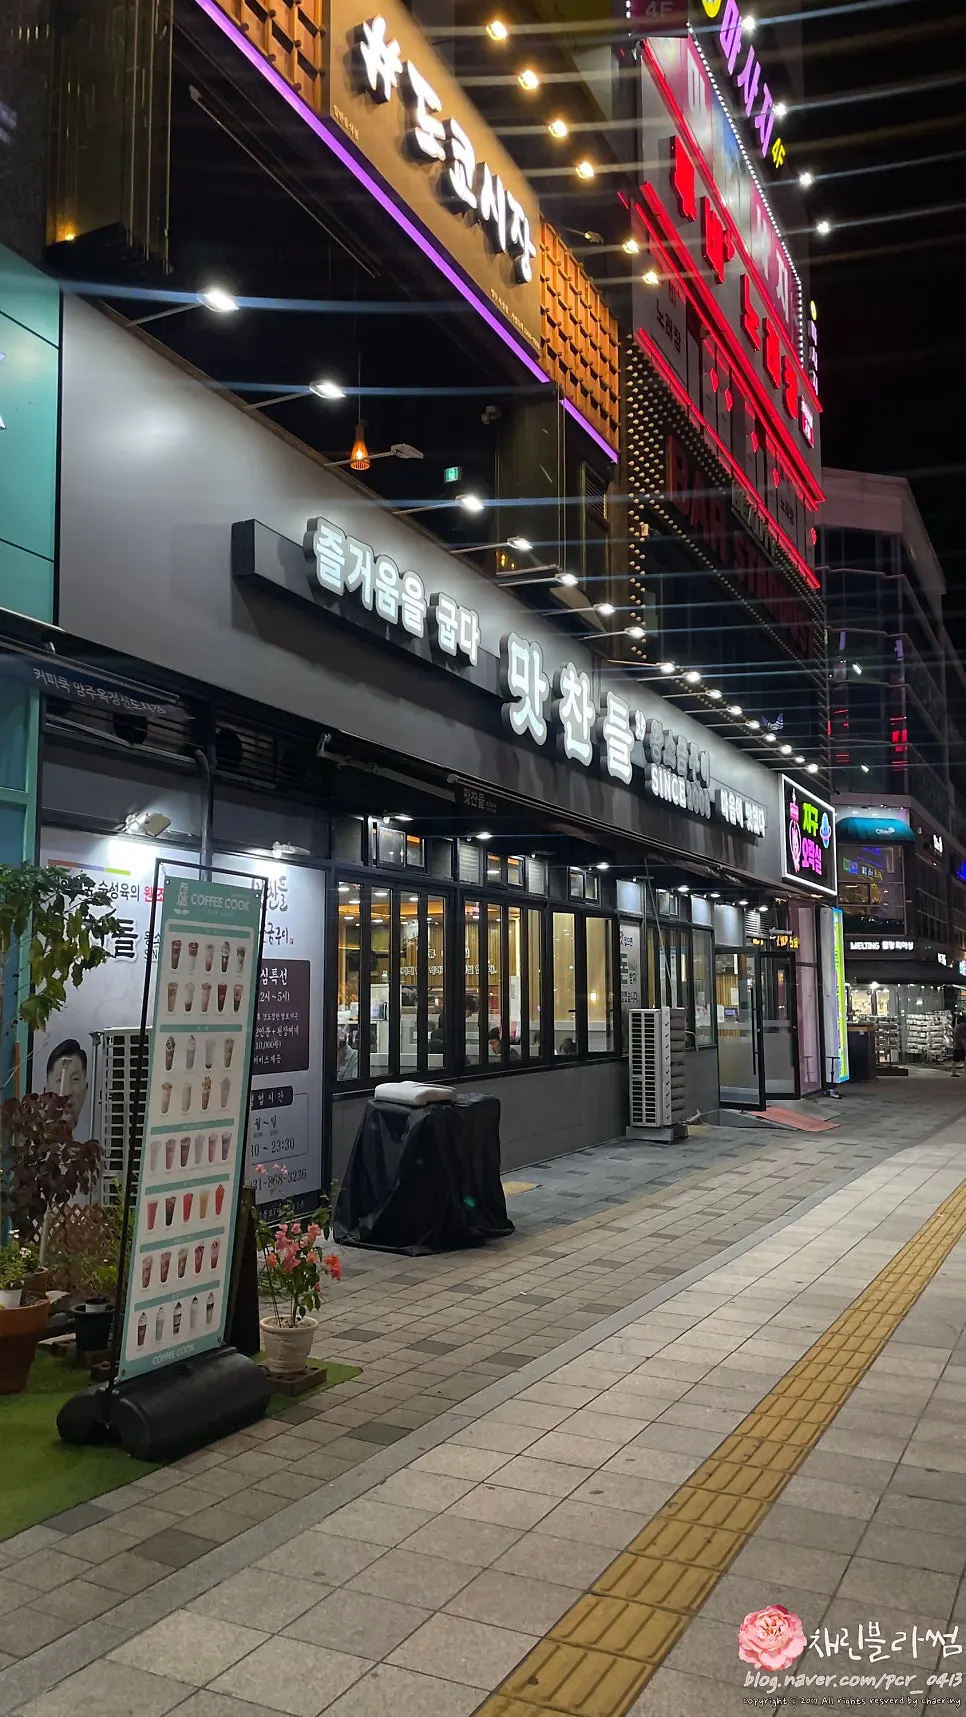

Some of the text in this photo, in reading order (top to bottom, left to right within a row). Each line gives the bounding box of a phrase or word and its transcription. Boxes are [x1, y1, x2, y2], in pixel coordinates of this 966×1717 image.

[645, 3, 673, 18] 4F
[313, 517, 482, 667] 즐거움을 굽다
[33, 667, 71, 694] 커피쿡
[507, 632, 635, 785] 맛찬들
[650, 762, 686, 809] SINCE
[803, 802, 818, 837] 지구
[191, 893, 223, 908] COFFEE
[224, 898, 251, 912] COOK
[850, 941, 880, 951] MELTING
[271, 1138, 295, 1154] 23:30
